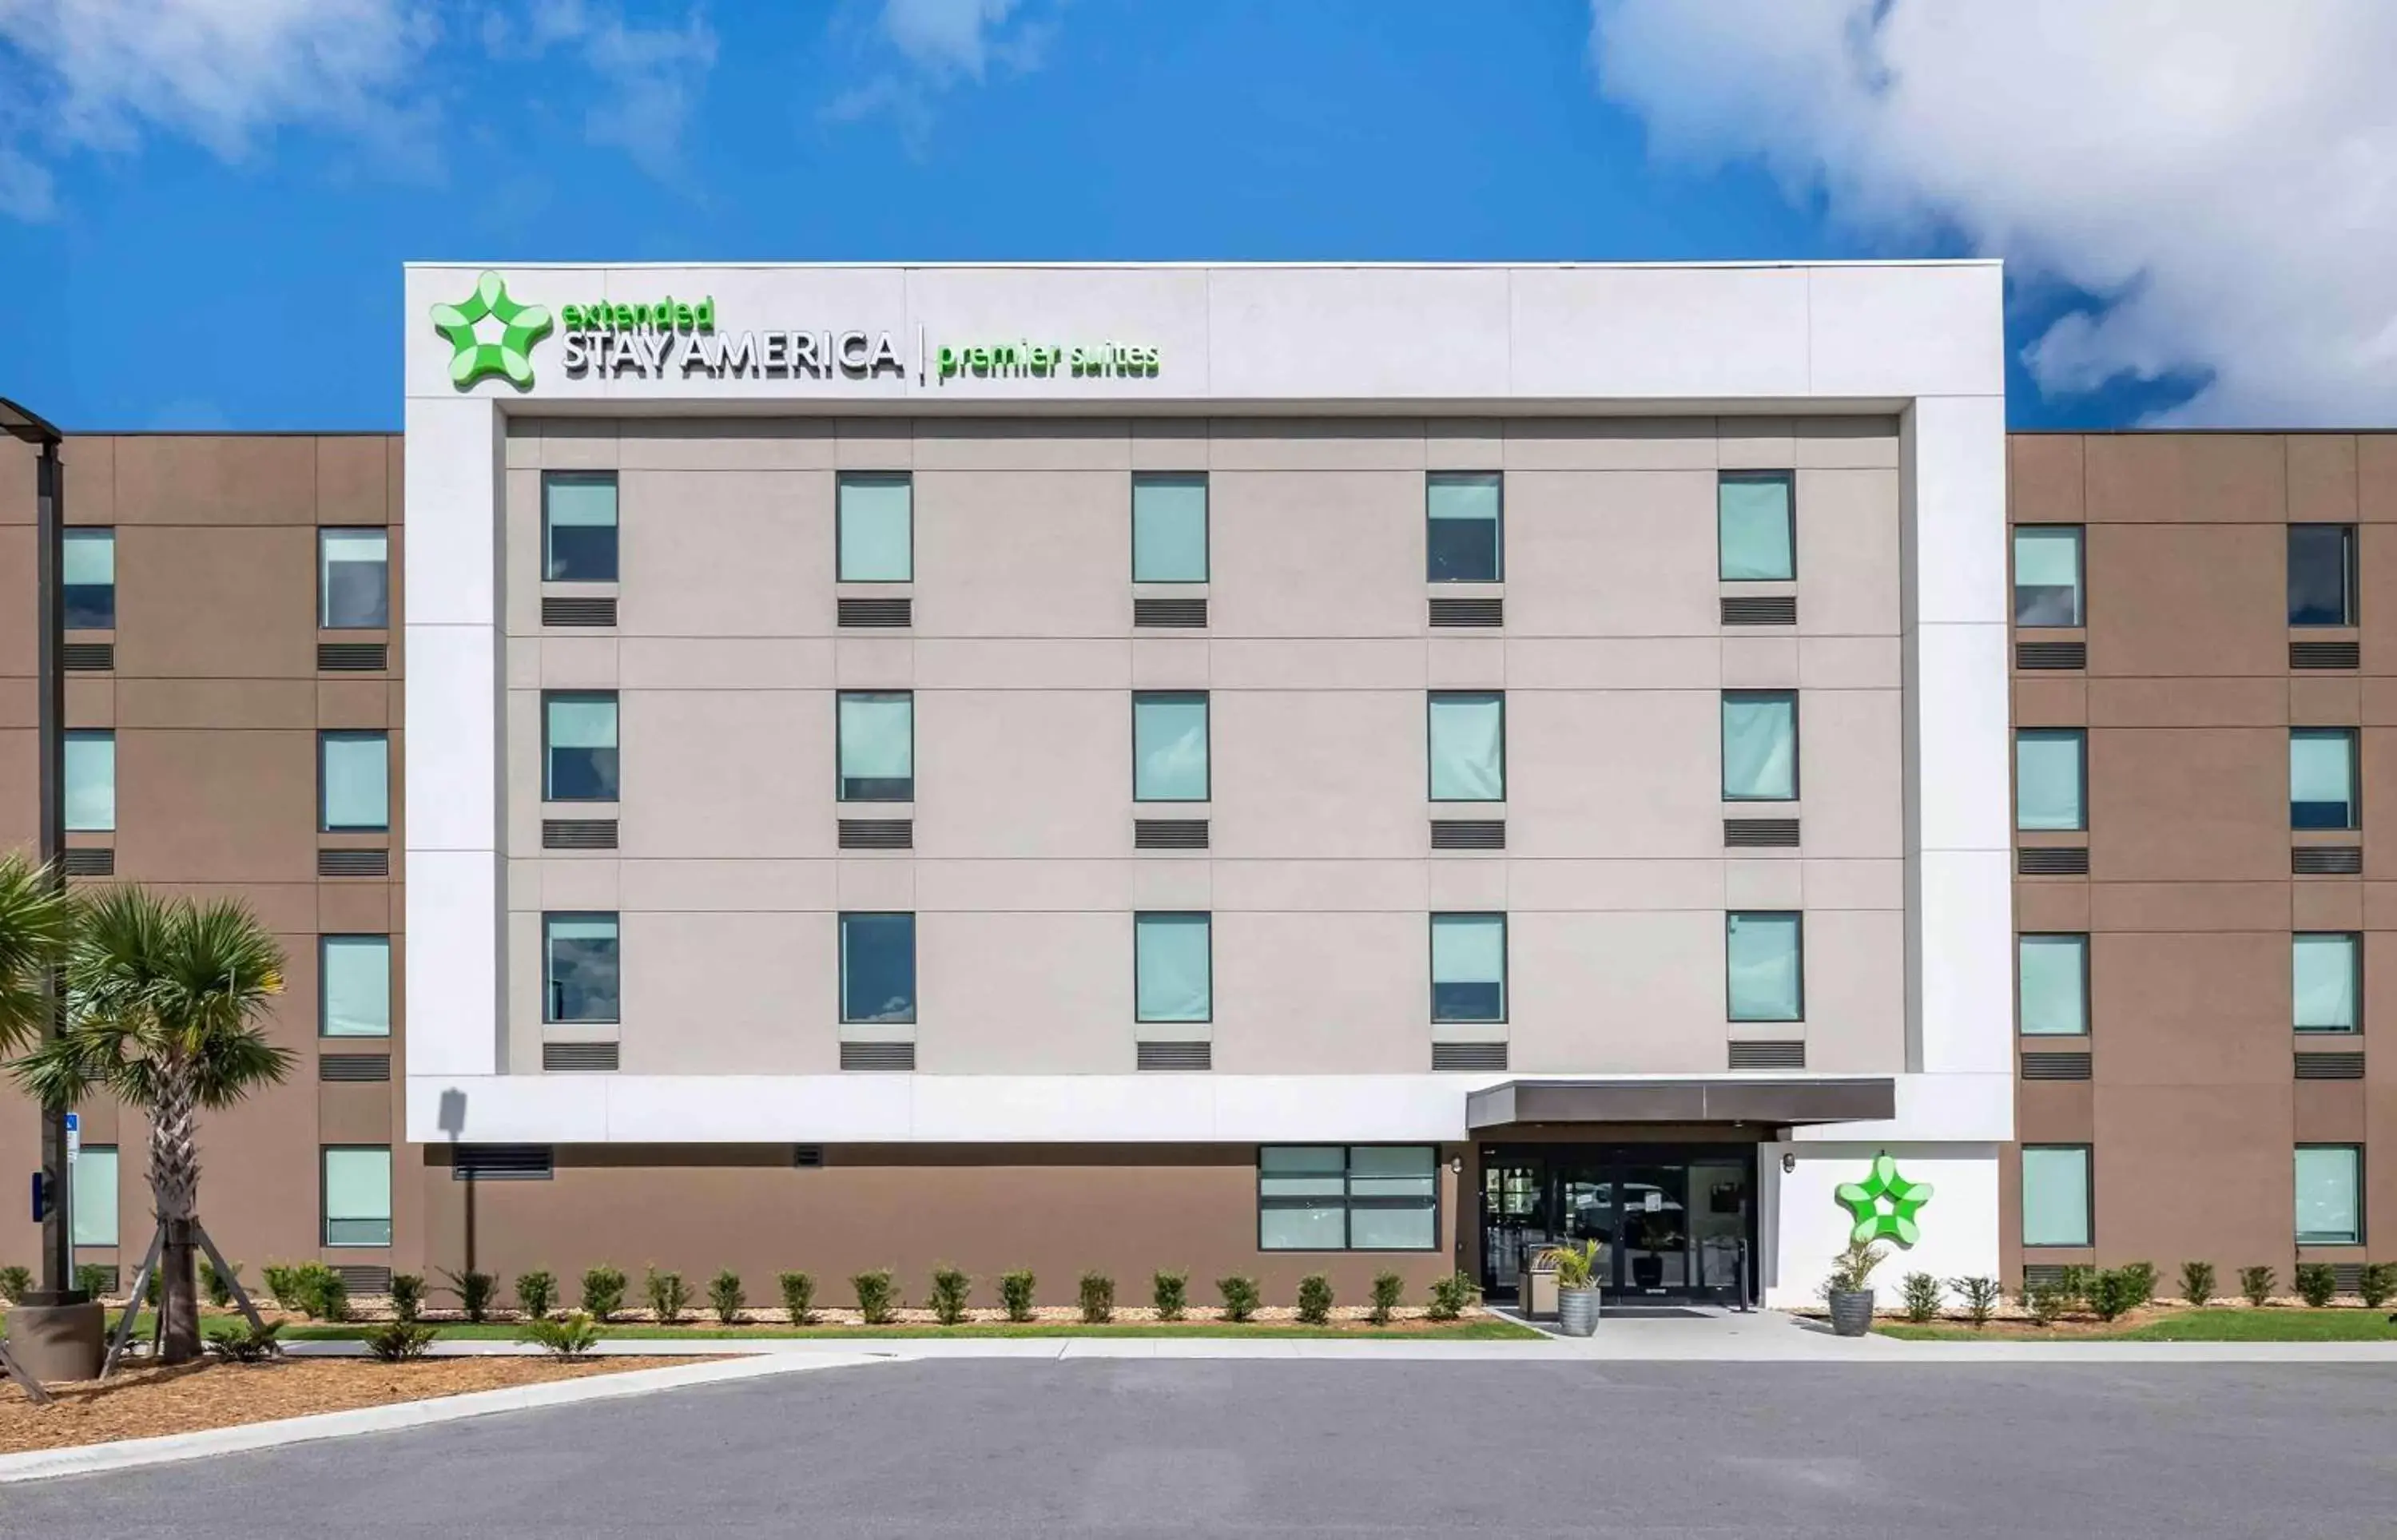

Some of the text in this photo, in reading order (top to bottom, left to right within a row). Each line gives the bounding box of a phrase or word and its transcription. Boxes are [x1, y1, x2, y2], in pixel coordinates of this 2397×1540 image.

[561, 295, 717, 331] extended
[562, 330, 905, 374] STAY AMERICA
[937, 337, 1162, 381] premier suites
